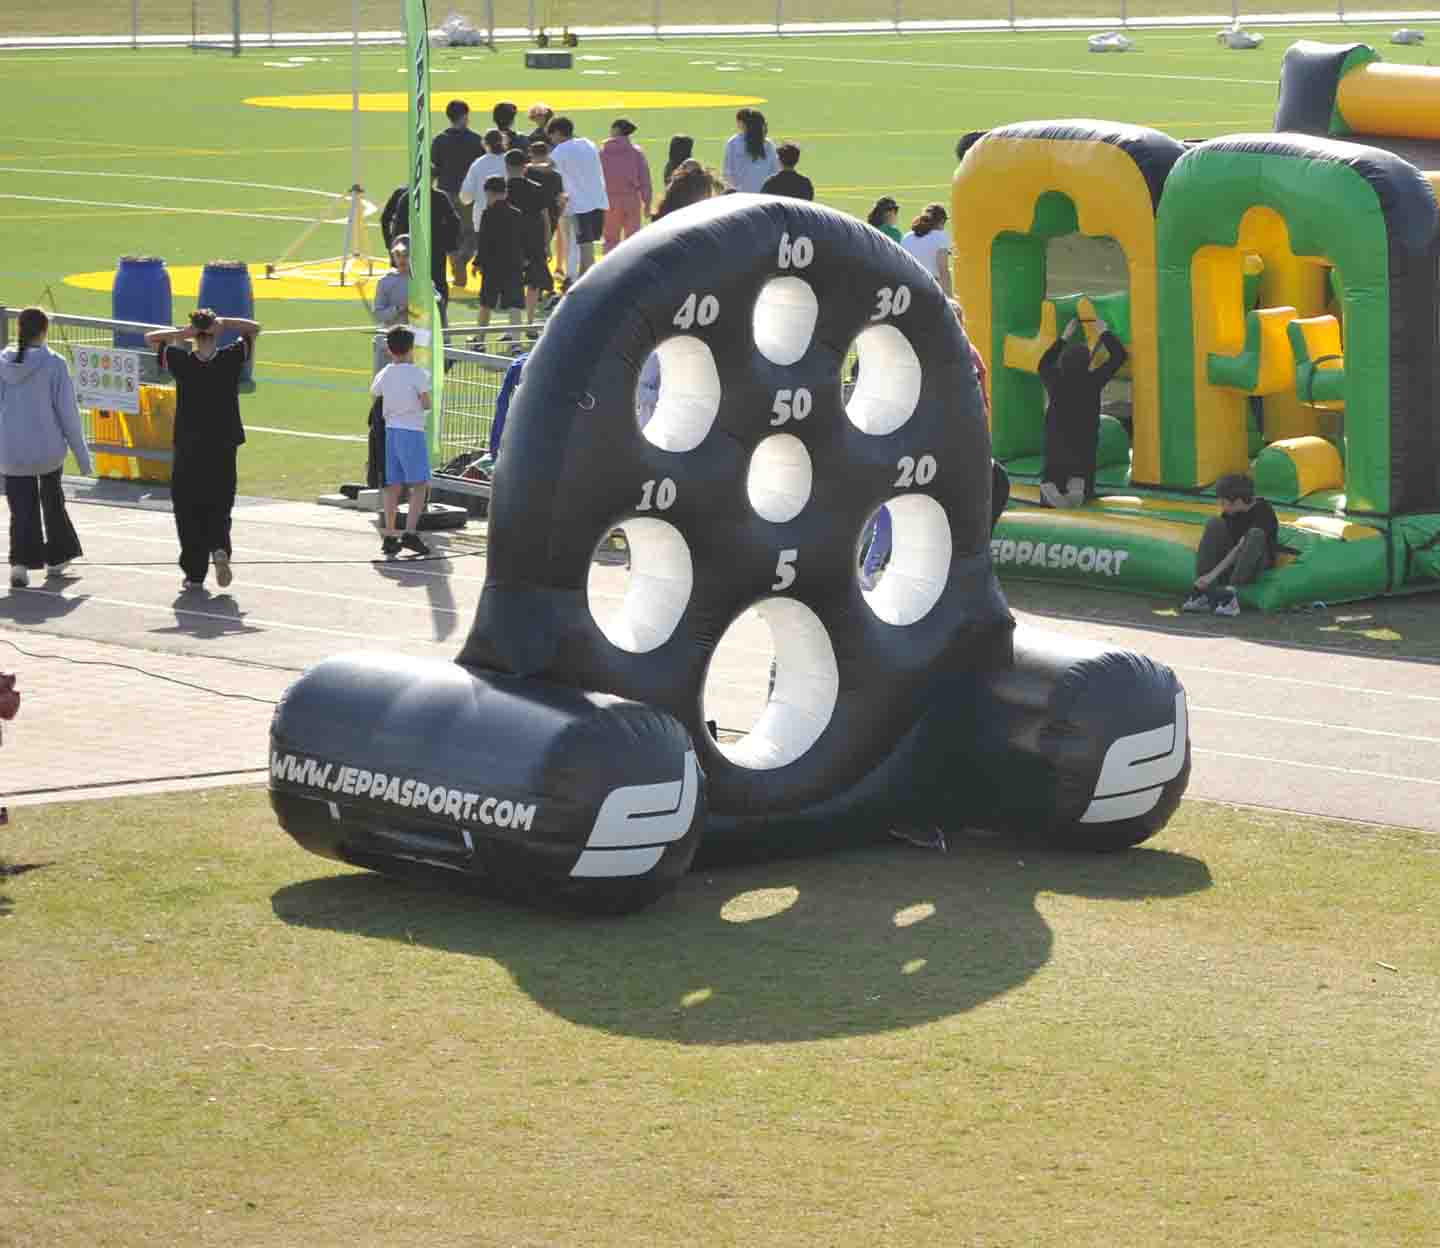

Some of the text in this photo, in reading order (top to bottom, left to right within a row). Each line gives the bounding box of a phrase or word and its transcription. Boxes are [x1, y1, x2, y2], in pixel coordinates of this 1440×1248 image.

[777, 231, 815, 270] 60
[671, 292, 720, 330] 40
[869, 285, 912, 322] 30
[769, 387, 813, 427] 50
[893, 454, 938, 489] 20
[635, 476, 678, 512] 10
[770, 548, 799, 591] 5
[989, 538, 1129, 577] EPPASPORT
[271, 751, 537, 832] WWW.JEPPASPORT.COM
